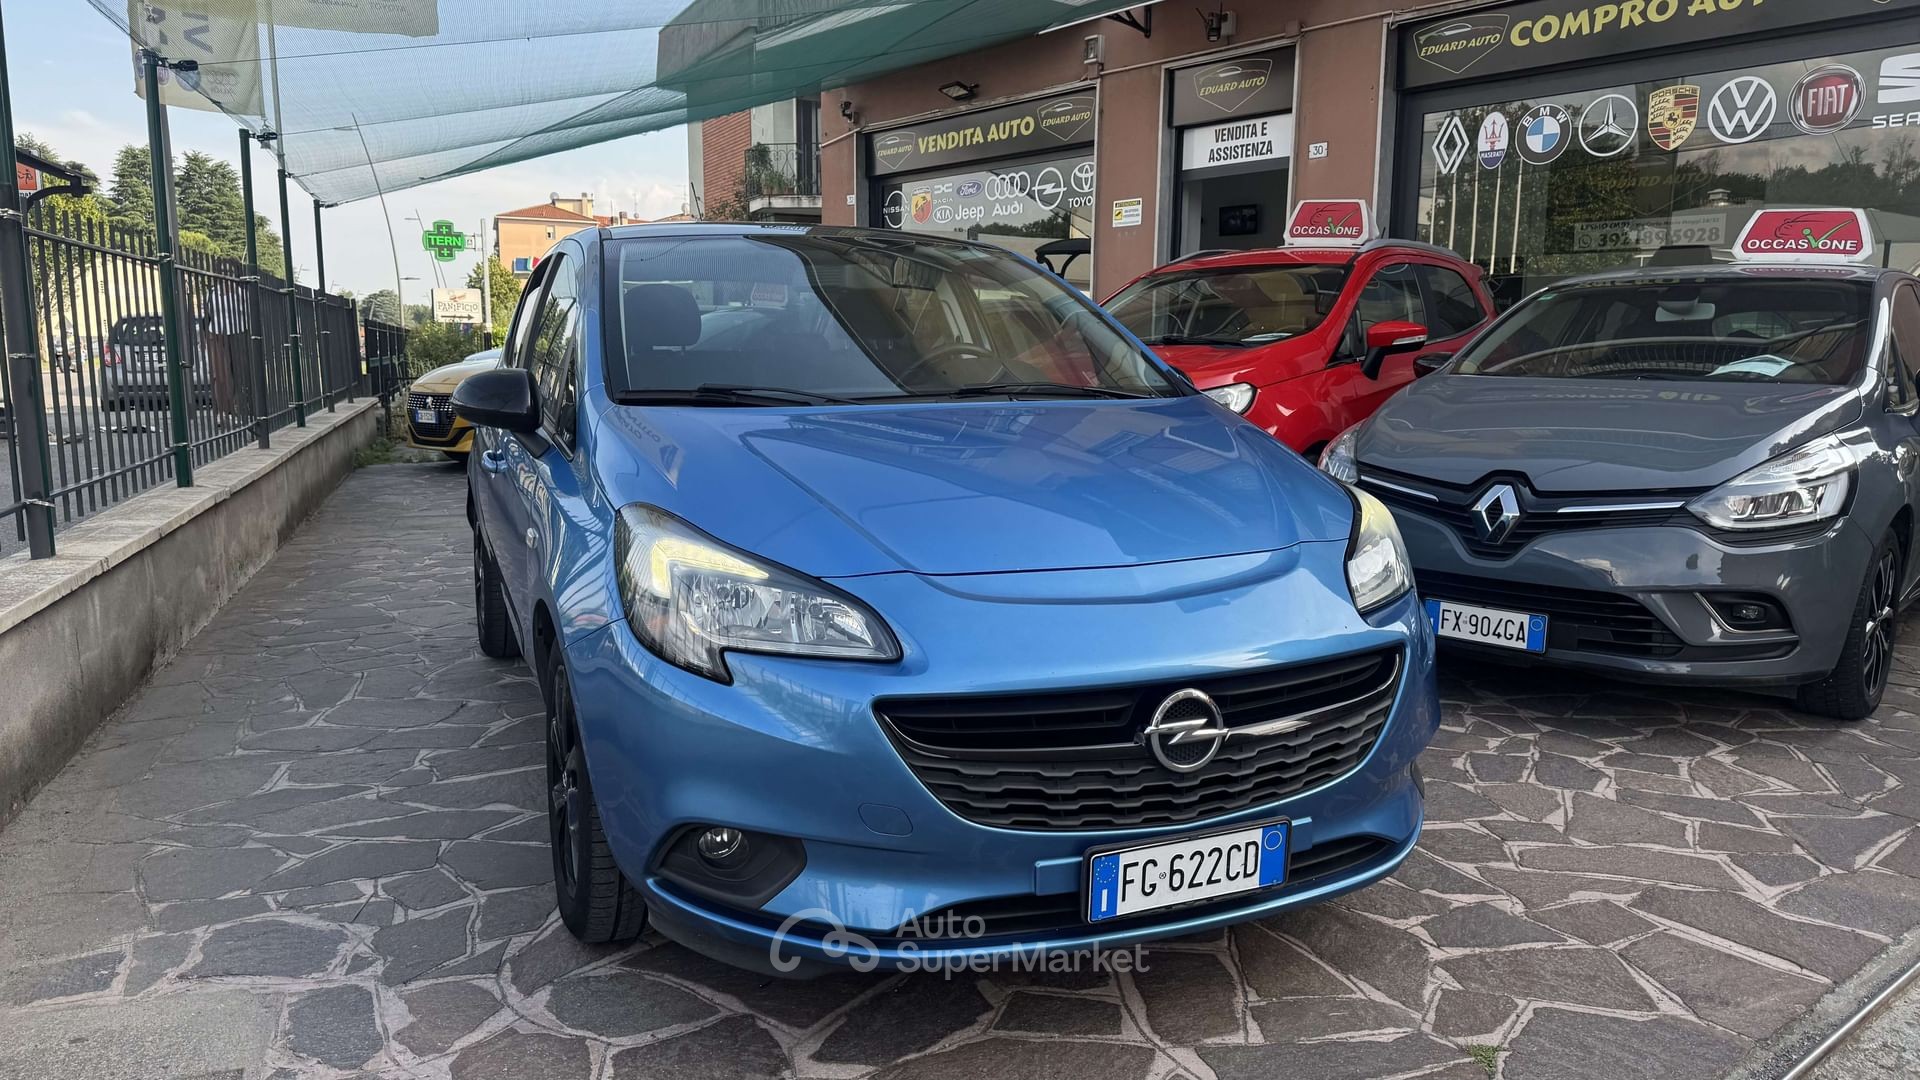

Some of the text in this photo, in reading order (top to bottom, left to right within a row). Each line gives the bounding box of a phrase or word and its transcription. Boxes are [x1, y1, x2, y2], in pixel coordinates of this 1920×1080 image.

[1510, 0, 1679, 46] COMPRO
[1420, 32, 1501, 57] EDUARD AUTO
[1199, 75, 1265, 96] EDUARD AUTO
[1807, 83, 1849, 117] FIAT
[1042, 111, 1091, 127] EDUARD AUTO
[1522, 106, 1568, 128] BMW
[1872, 111, 1920, 129] SEA
[918, 115, 1036, 154] VENDITA AUTO
[1214, 121, 1268, 144] VENDITA E
[1208, 139, 1273, 163] ASSISTENZA
[1312, 145, 1324, 155] 30
[960, 183, 978, 196] Ford
[883, 205, 910, 214] NISSAN
[992, 201, 1024, 217] Audi
[1068, 195, 1094, 208] TOYO
[936, 209, 951, 220] KIA
[955, 204, 985, 221] Jeep
[427, 235, 463, 246] TERN
[437, 301, 478, 312] PANIFICIO
